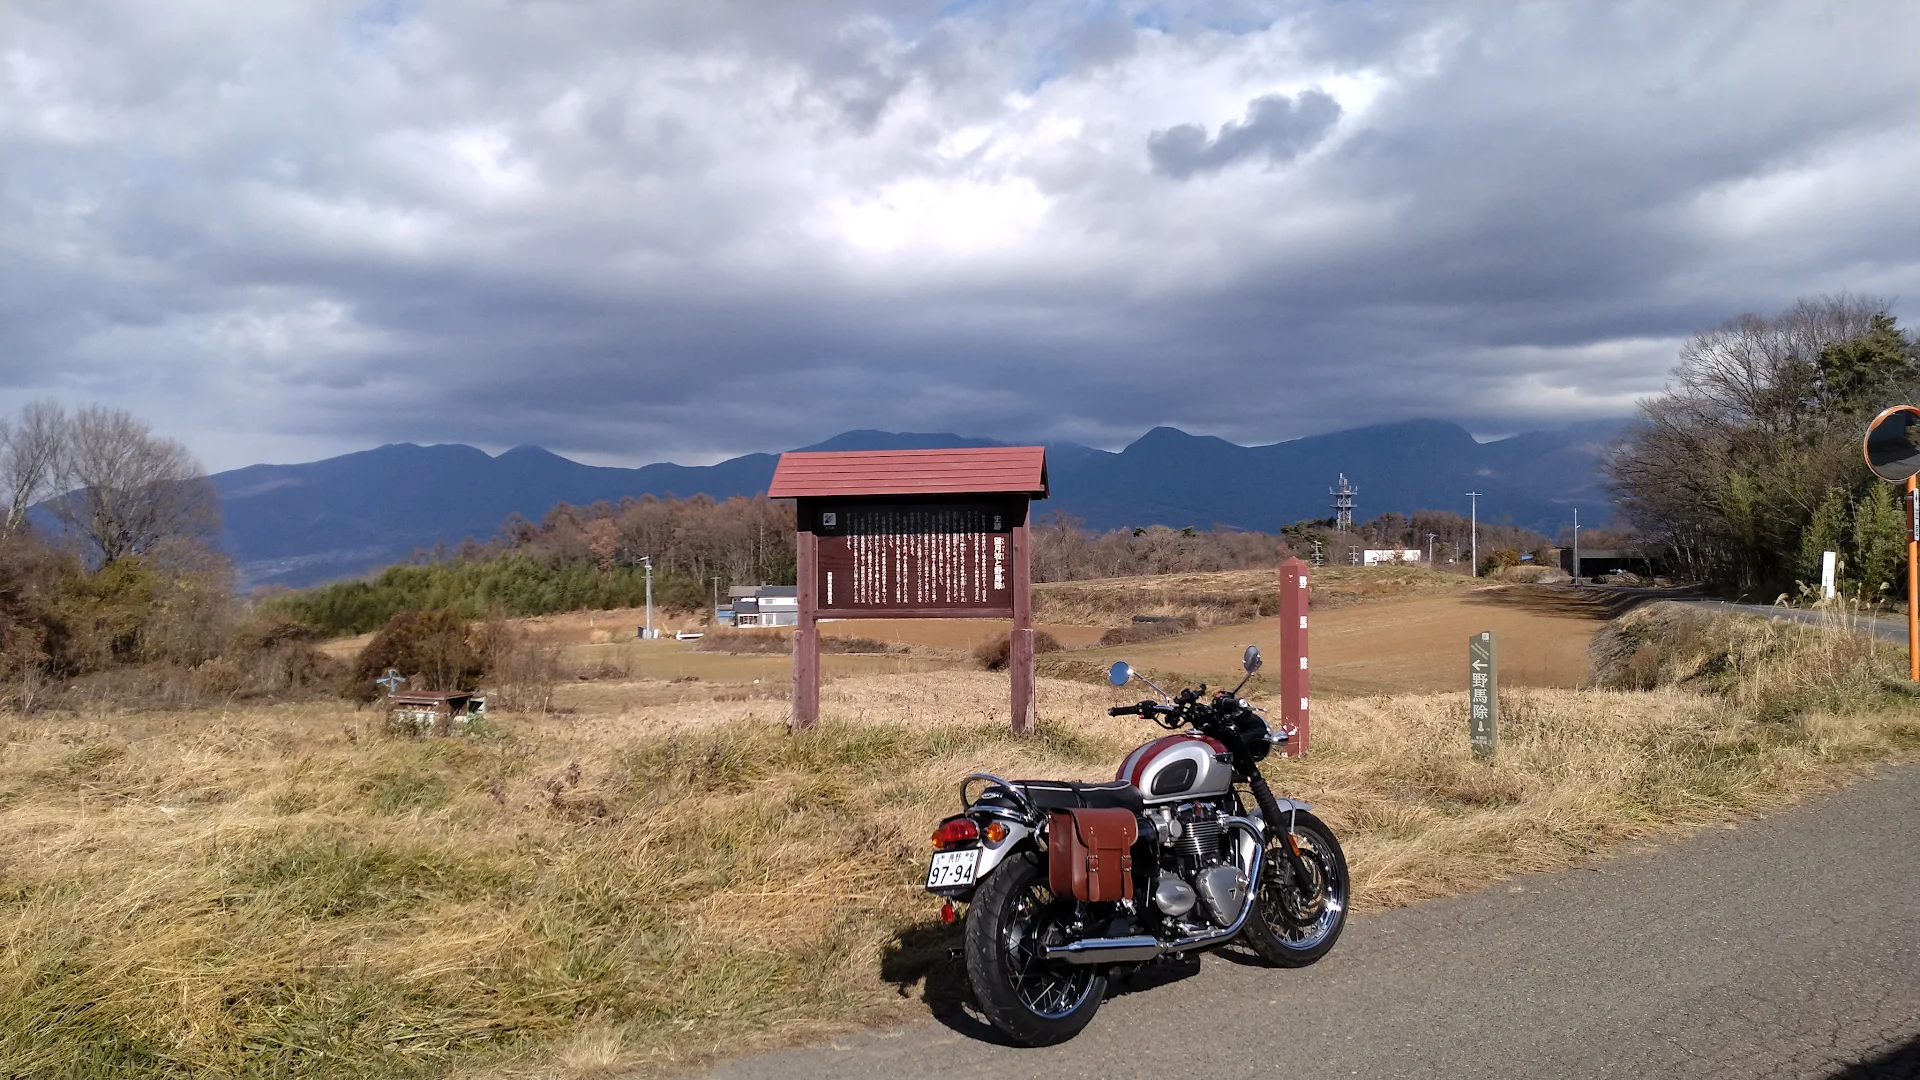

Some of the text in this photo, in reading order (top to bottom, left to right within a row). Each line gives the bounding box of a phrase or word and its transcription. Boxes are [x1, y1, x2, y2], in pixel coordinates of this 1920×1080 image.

[1472, 672, 1489, 720] 野馬除
[930, 864, 973, 885] 97-94
